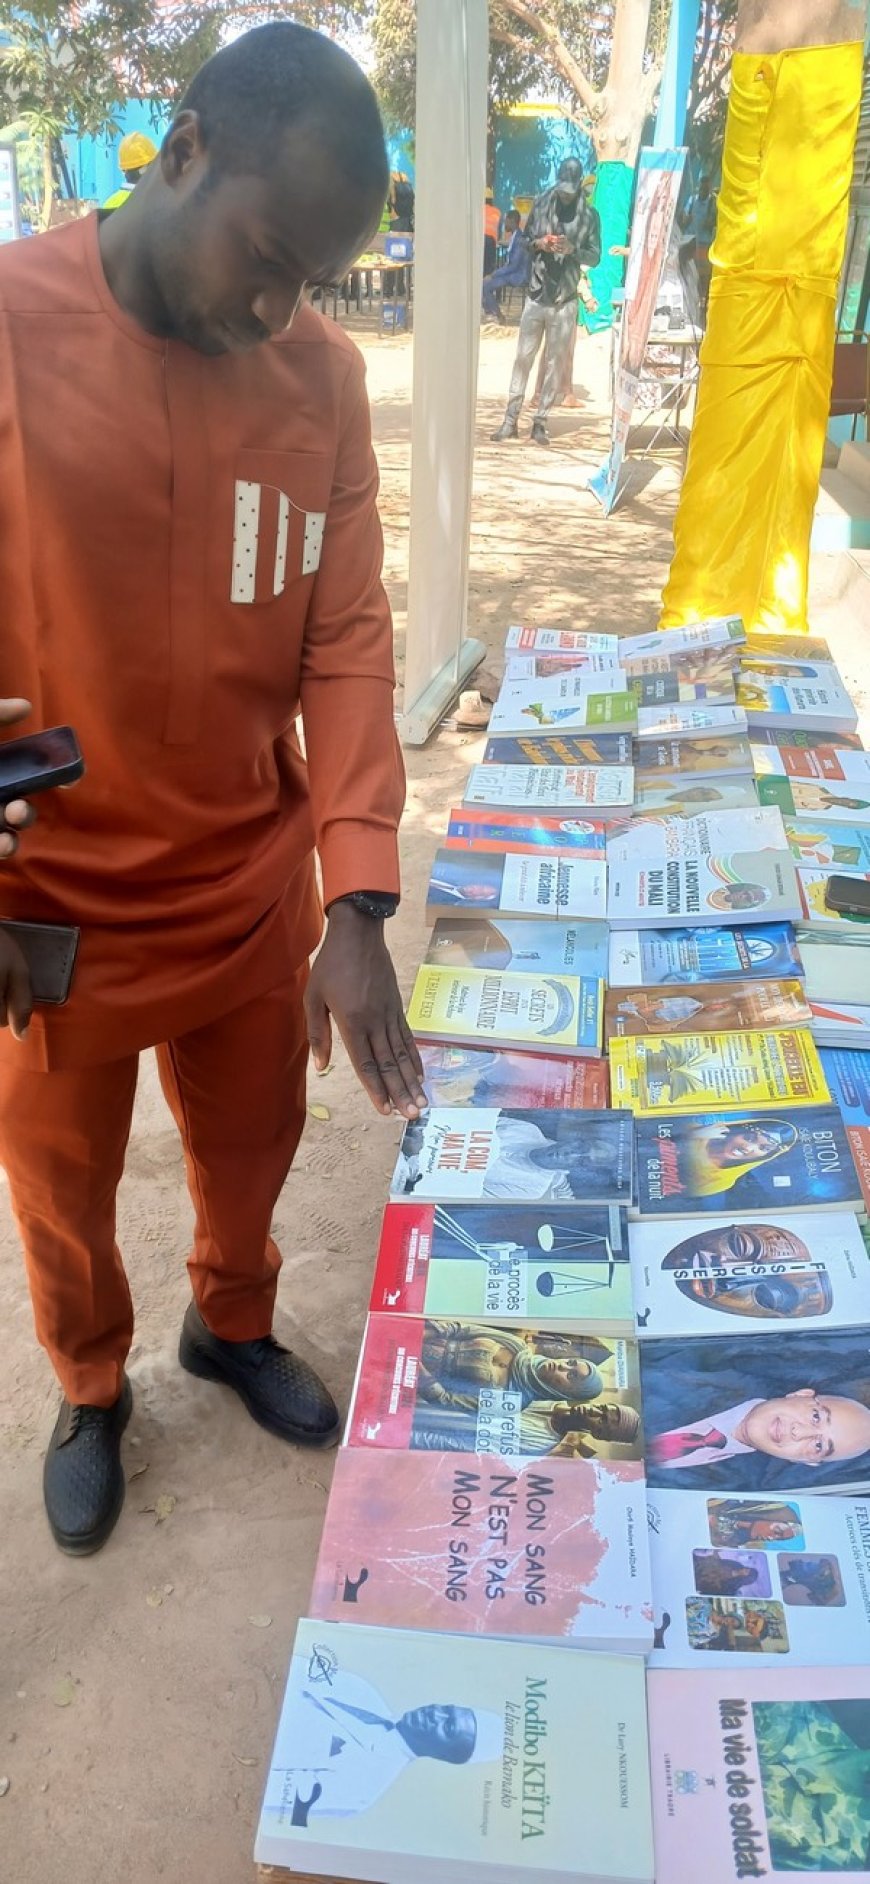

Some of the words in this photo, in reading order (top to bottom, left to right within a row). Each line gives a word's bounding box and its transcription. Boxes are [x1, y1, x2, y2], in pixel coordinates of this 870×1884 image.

[695, 818, 711, 855] DICTIONNAIRE
[648, 870, 663, 883] DU
[684, 860, 698, 870] LA
[537, 862, 556, 905] africaine
[555, 863, 574, 906] Jeunesse
[648, 885, 663, 906] MALI
[666, 861, 681, 914] CONSTITUTION
[685, 871, 700, 913] NOUVELLE
[477, 975, 502, 1029] MILLIONNAIRE
[500, 991, 520, 1015] ESPRIT
[528, 989, 546, 1022] SECRETS
[441, 1133, 466, 1149] MA
[469, 1130, 493, 1143] LA
[657, 1123, 673, 1138] Les
[437, 1153, 462, 1169] VIE
[461, 1146, 491, 1173] COM,
[647, 1158, 663, 1170] de
[801, 1144, 819, 1180] KOULIBALY
[812, 1130, 841, 1173] BITON
[648, 1171, 663, 1179] la
[652, 1137, 688, 1196] piments
[649, 1181, 664, 1200] nuit
[488, 1260, 503, 1276] de
[508, 1250, 522, 1266] Le
[673, 1262, 826, 1279] FISSURES
[487, 1278, 502, 1289] la
[502, 1269, 525, 1310] procès
[486, 1292, 502, 1310] vie
[480, 1390, 496, 1408] de
[502, 1391, 519, 1411] Le
[479, 1411, 495, 1425] la
[476, 1429, 494, 1453] dot
[500, 1415, 518, 1456] refus
[489, 1475, 518, 1545] N'EST
[446, 1539, 468, 1602] SANG
[485, 1558, 506, 1600] PAS
[525, 1543, 546, 1605] SANG
[855, 1562, 865, 1572] de
[505, 1700, 521, 1710] le
[522, 1676, 549, 1756] Modibo
[718, 1698, 748, 1730] Ma
[504, 1711, 520, 1736] lion
[617, 1722, 626, 1733] Dr
[503, 1737, 520, 1754] de
[722, 1733, 752, 1766] vie
[500, 1754, 518, 1809] Bamako
[618, 1752, 629, 1809] NKOUESSOM
[664, 1753, 673, 1787] LIBRAIRIE
[725, 1770, 756, 1798] de
[522, 1759, 551, 1841] KEÏTA
[728, 1802, 767, 1879] soldat
